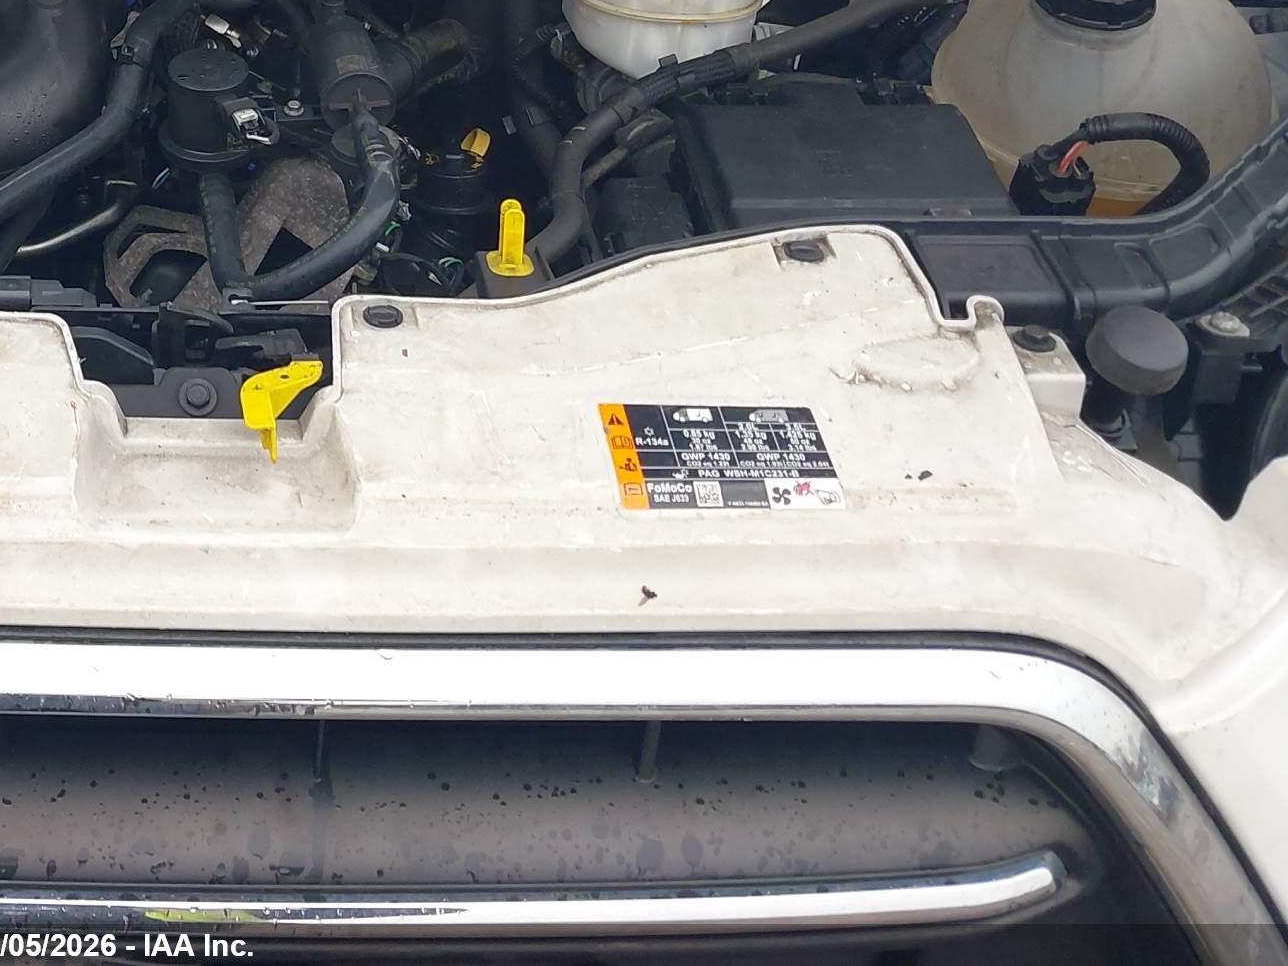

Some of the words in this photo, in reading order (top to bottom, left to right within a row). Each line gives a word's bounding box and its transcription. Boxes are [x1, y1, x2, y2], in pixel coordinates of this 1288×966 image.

[635, 436, 669, 446] R-134a
[682, 452, 705, 461] GWP
[707, 452, 731, 461] 1430
[756, 452, 780, 461] GWP
[783, 452, 806, 461] 1430
[698, 469, 720, 478] PAG
[646, 482, 692, 493] FoMoCo
